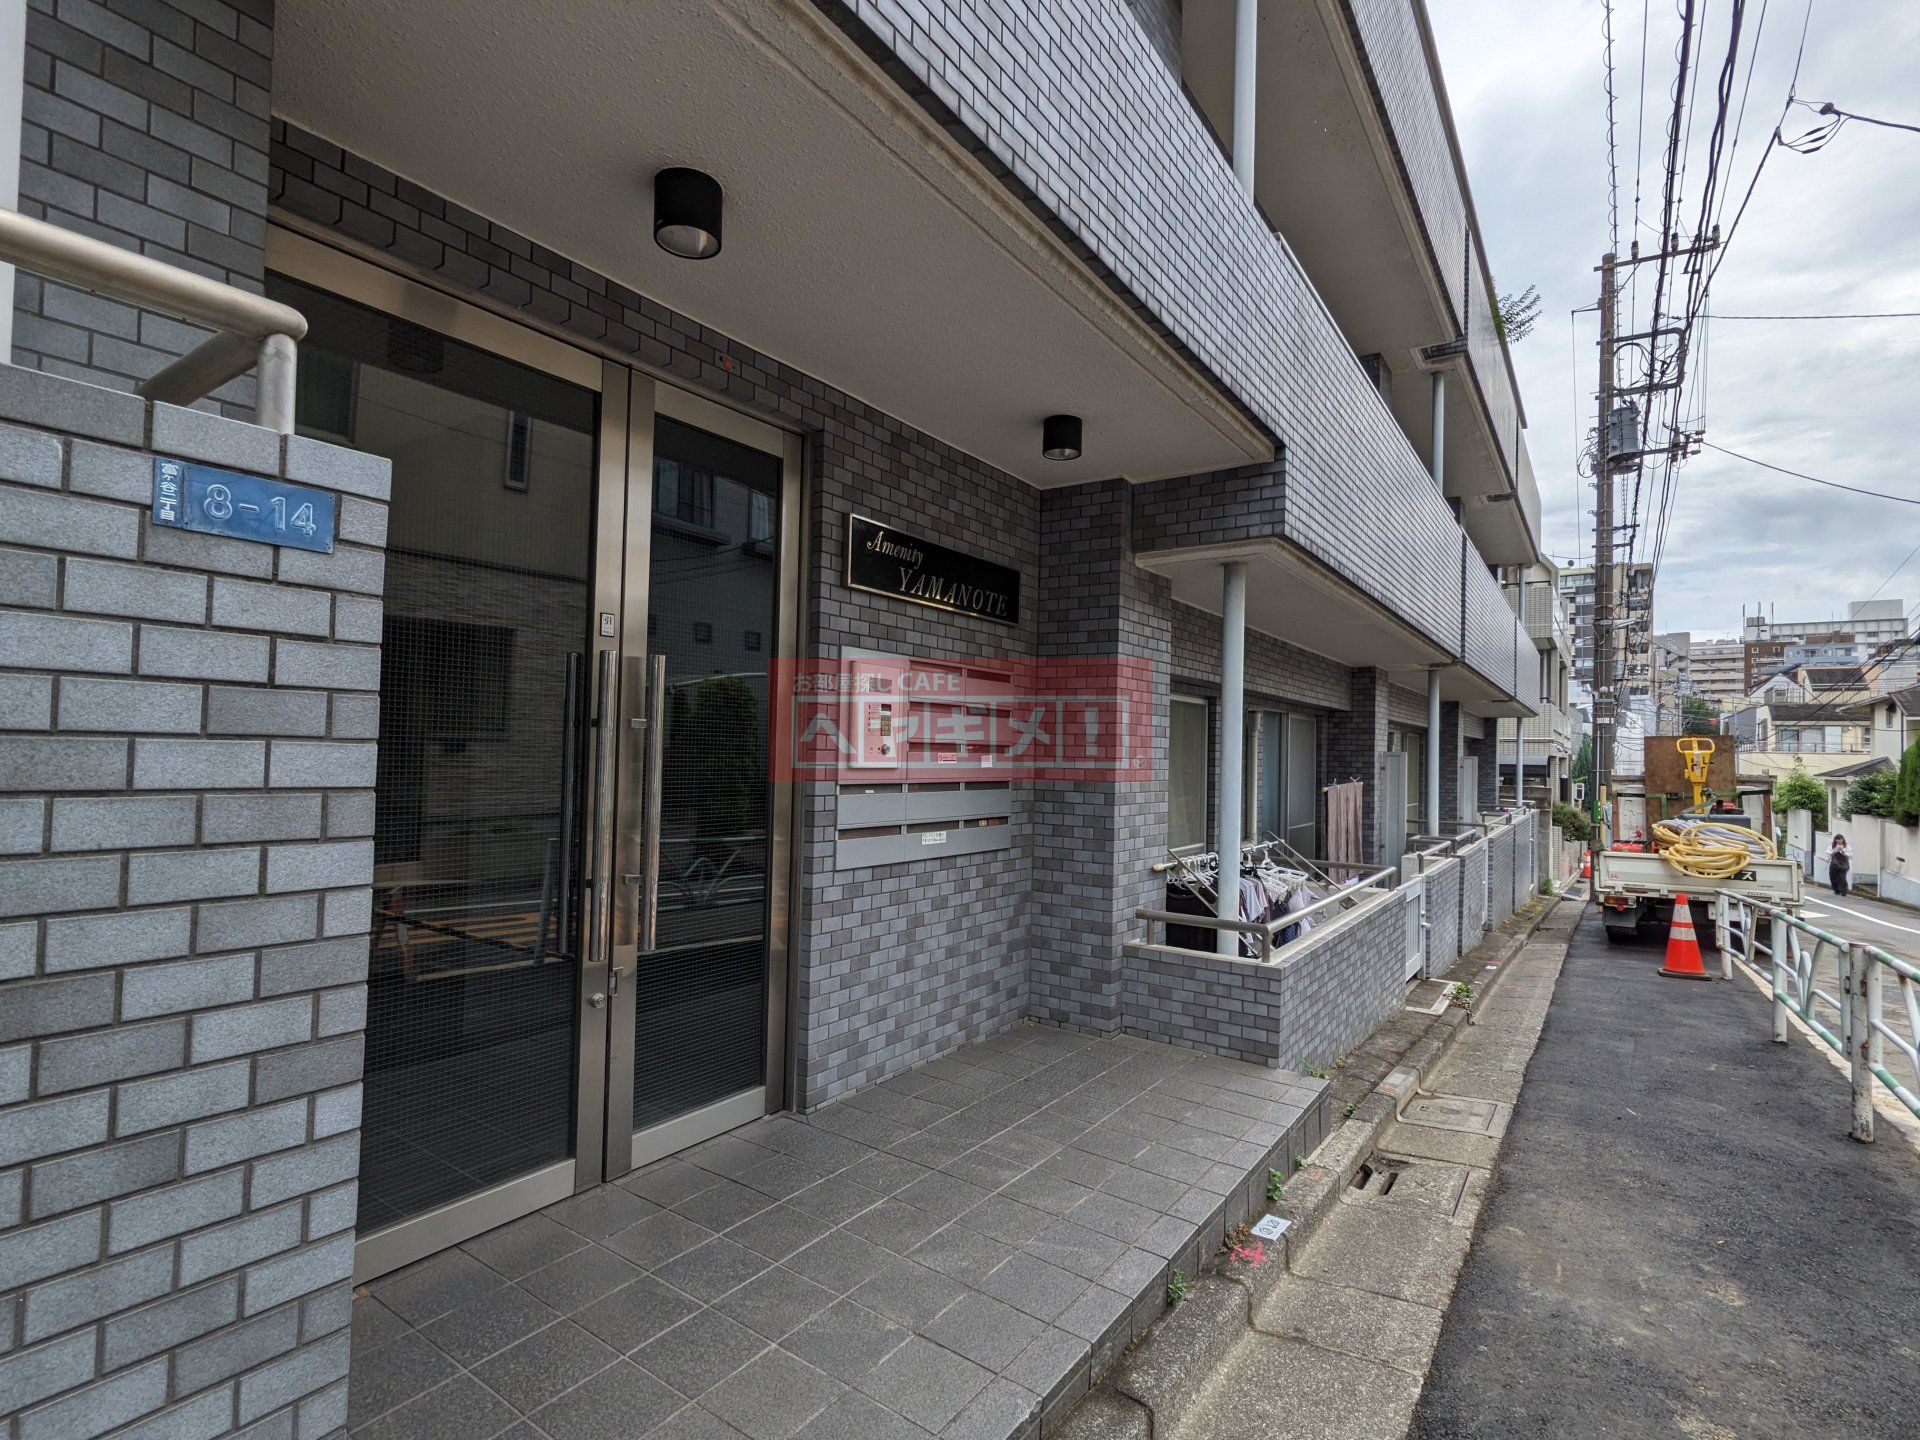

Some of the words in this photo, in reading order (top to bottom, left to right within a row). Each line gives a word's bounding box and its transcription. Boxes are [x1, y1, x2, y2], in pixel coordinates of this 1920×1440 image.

[203, 484, 316, 537] 8-14
[866, 530, 925, 569] Amenity
[899, 566, 1009, 617] YAMANOTE
